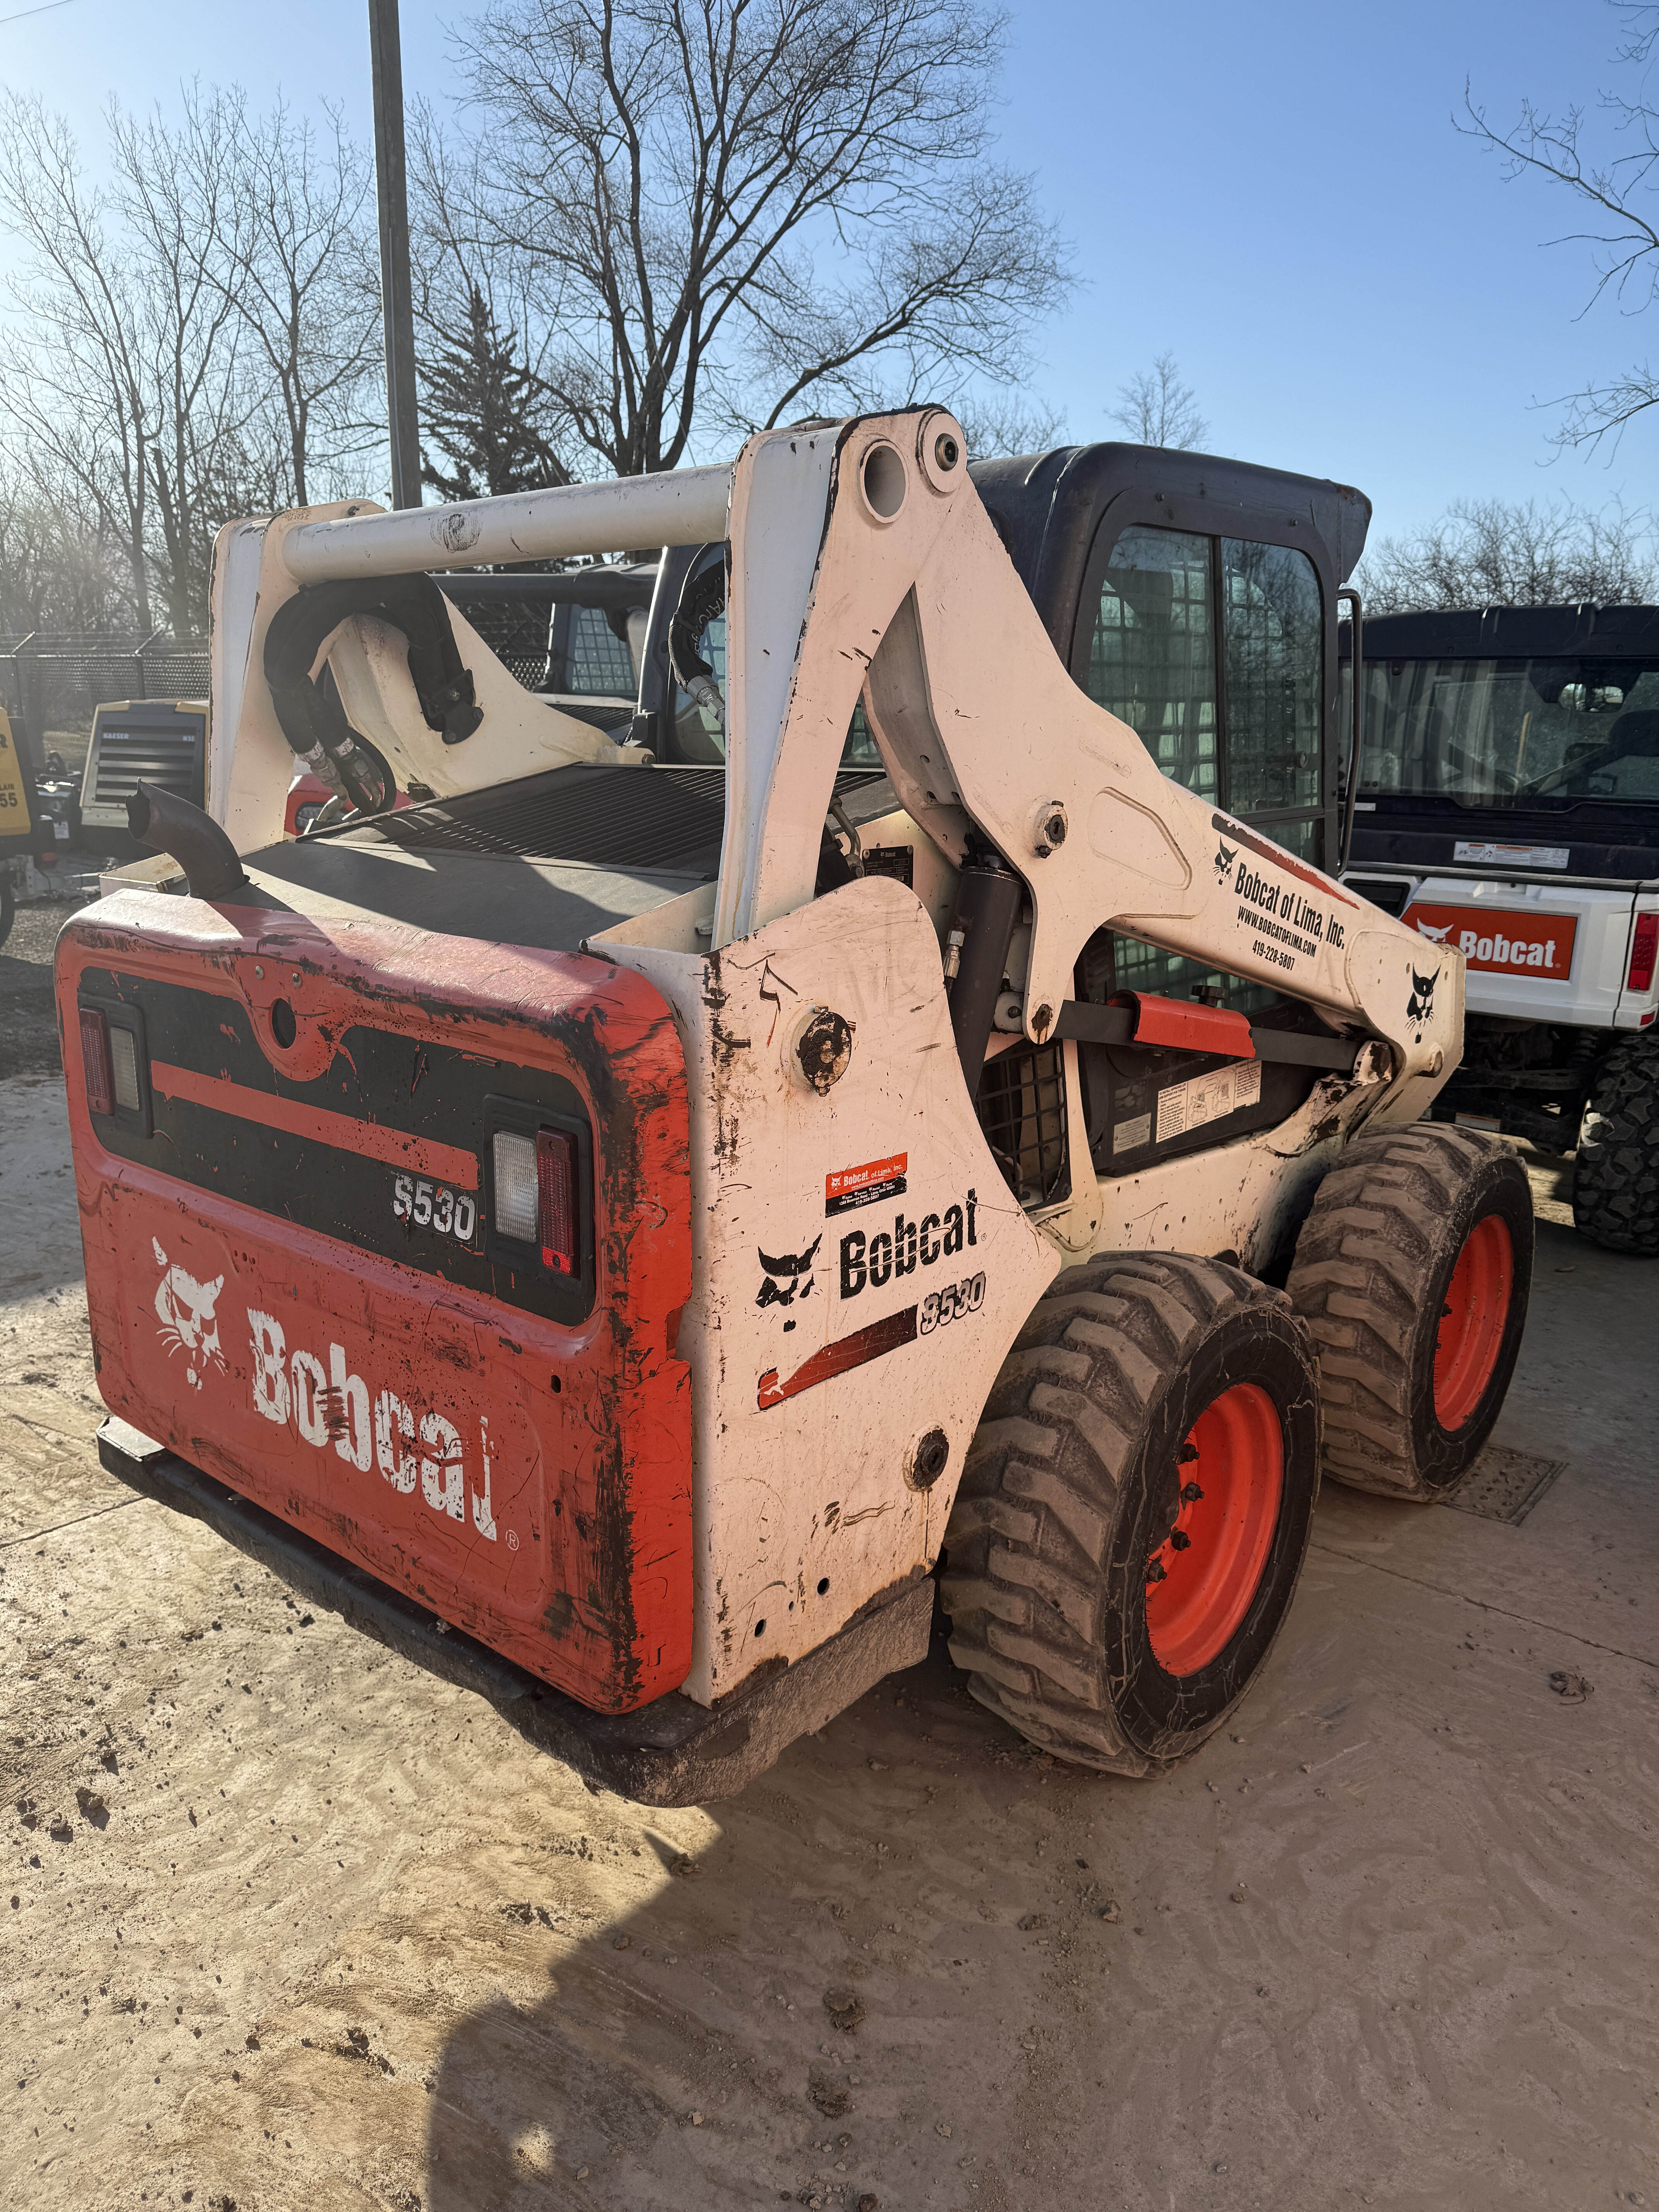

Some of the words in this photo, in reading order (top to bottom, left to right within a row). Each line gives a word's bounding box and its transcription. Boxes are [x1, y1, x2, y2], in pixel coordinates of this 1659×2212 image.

[1235, 862, 1280, 914] Bobcat
[1280, 893, 1295, 921] of
[1293, 896, 1323, 942] Lima,
[1326, 914, 1345, 950] Inc.
[1238, 905, 1317, 958] WWW.BOBCATOFLIMA.COM
[1252, 940, 1295, 971] 419-228-5807
[1459, 931, 1556, 968] Bobcat
[393, 1175, 475, 1240] S530
[844, 1170, 869, 1187] Bobcat
[840, 1188, 978, 1301] Bobcat
[247, 1307, 497, 1541] Bobcat
